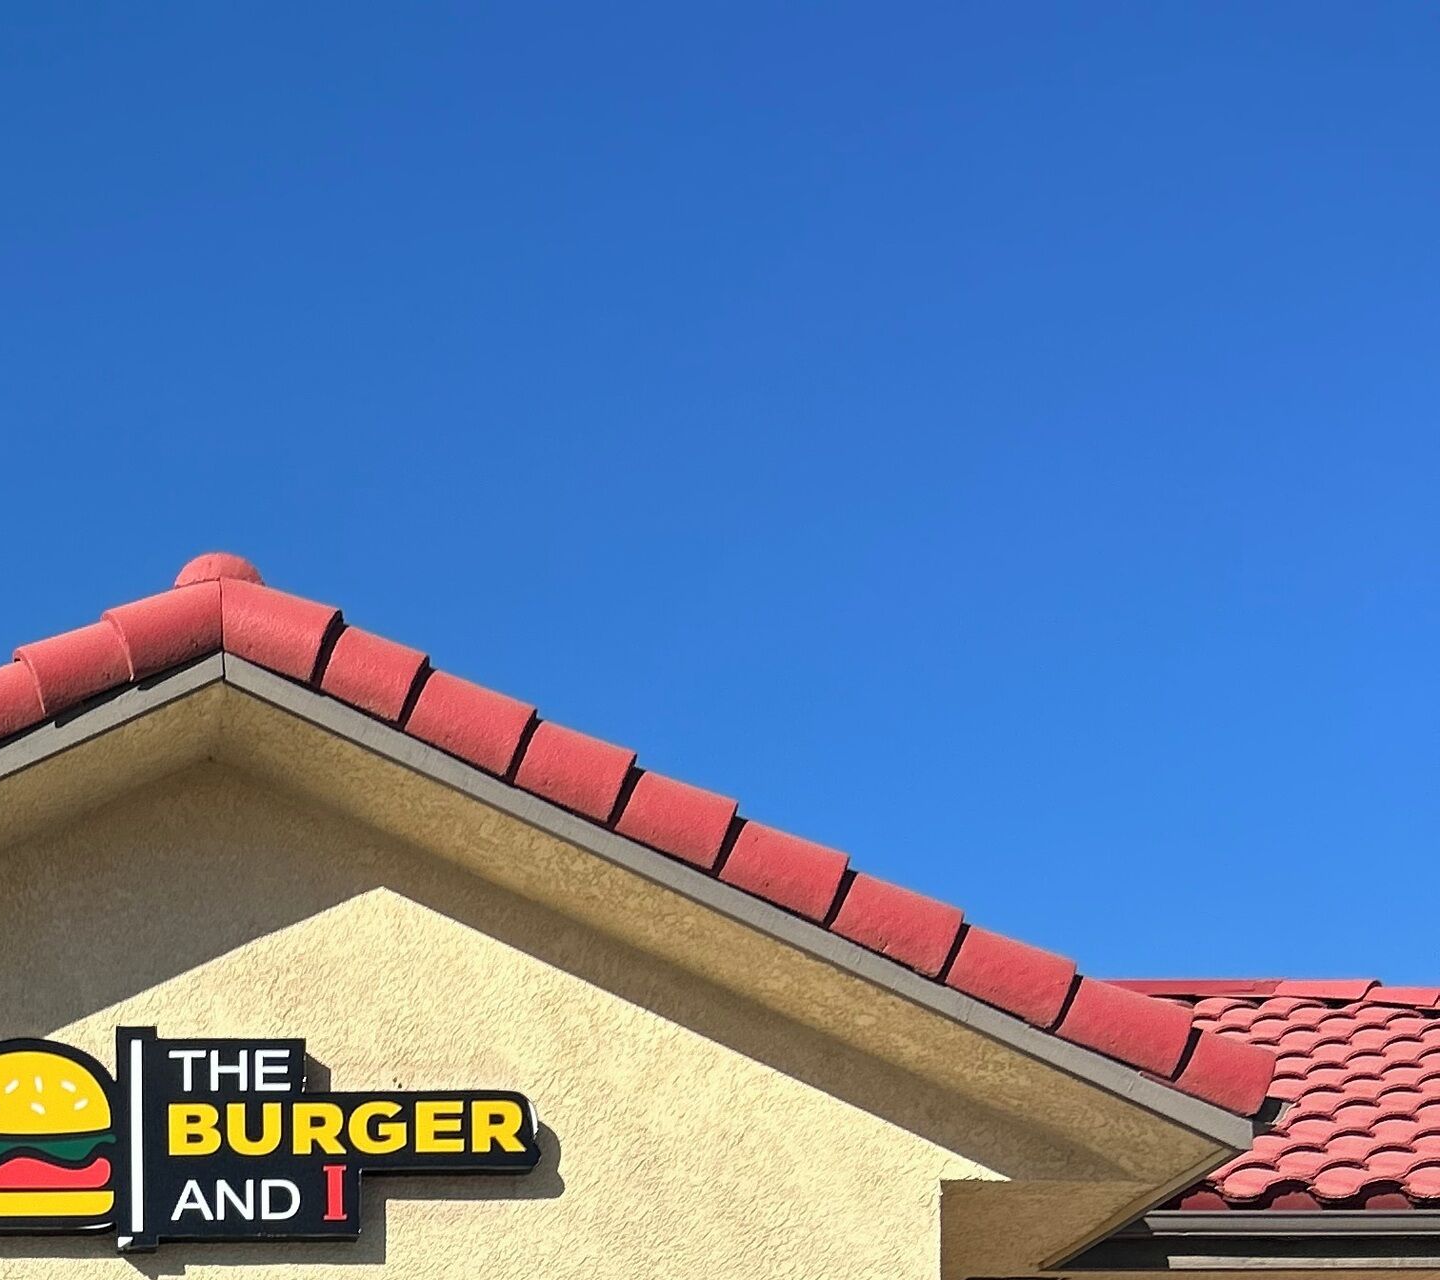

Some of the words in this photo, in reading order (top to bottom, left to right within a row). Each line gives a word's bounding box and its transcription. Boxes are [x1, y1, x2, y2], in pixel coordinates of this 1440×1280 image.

[168, 1049, 292, 1092] THE
[168, 1100, 527, 1156] BURGER
[171, 1179, 301, 1221] AND
[323, 1165, 347, 1221] I
